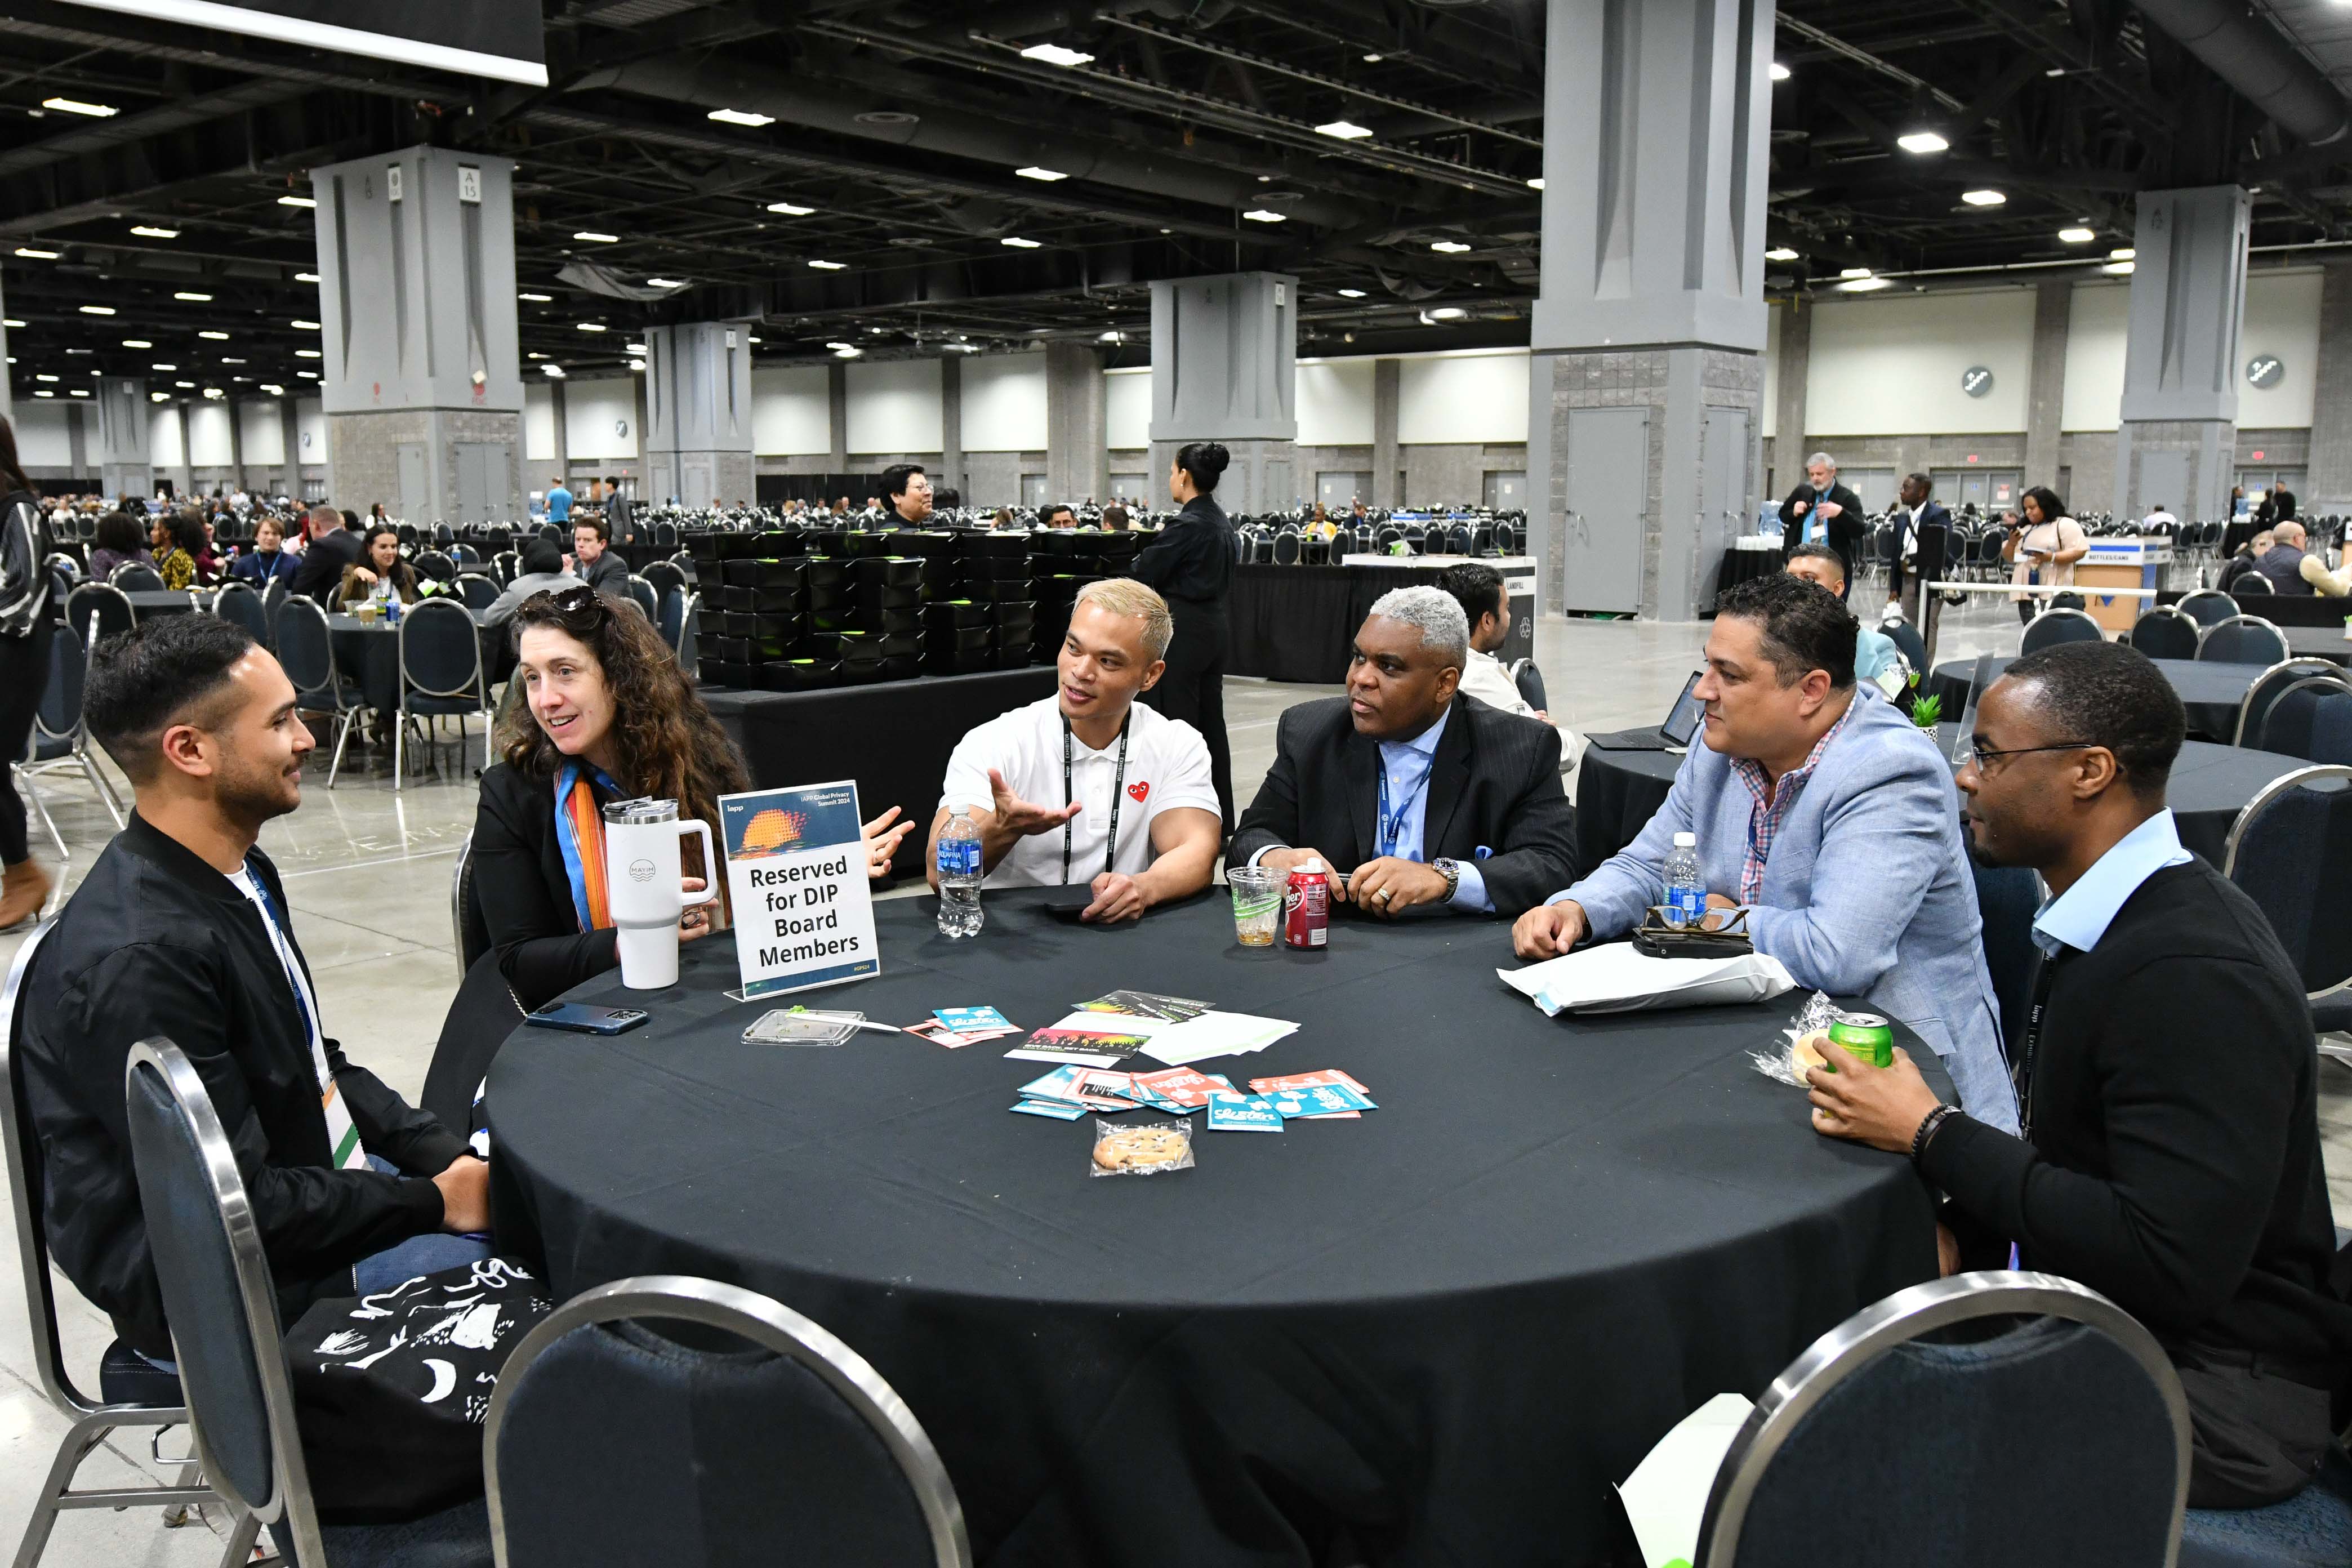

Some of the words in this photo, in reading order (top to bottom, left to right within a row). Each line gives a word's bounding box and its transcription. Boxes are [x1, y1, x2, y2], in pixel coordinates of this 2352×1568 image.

[465, 172, 474, 183] A
[464, 185, 476, 197] 15
[1507, 581, 1524, 590] LANDFILL
[939, 850, 961, 859] AQUAFINA
[750, 855, 848, 888] Reserved
[766, 892, 797, 912] for
[804, 884, 838, 906] DIP
[1286, 892, 1300, 906] per
[774, 909, 838, 937] Board
[760, 936, 859, 967] Members
[2032, 1005, 2042, 1023] iapp
[2027, 1035, 2036, 1073] EXHIBITOR
